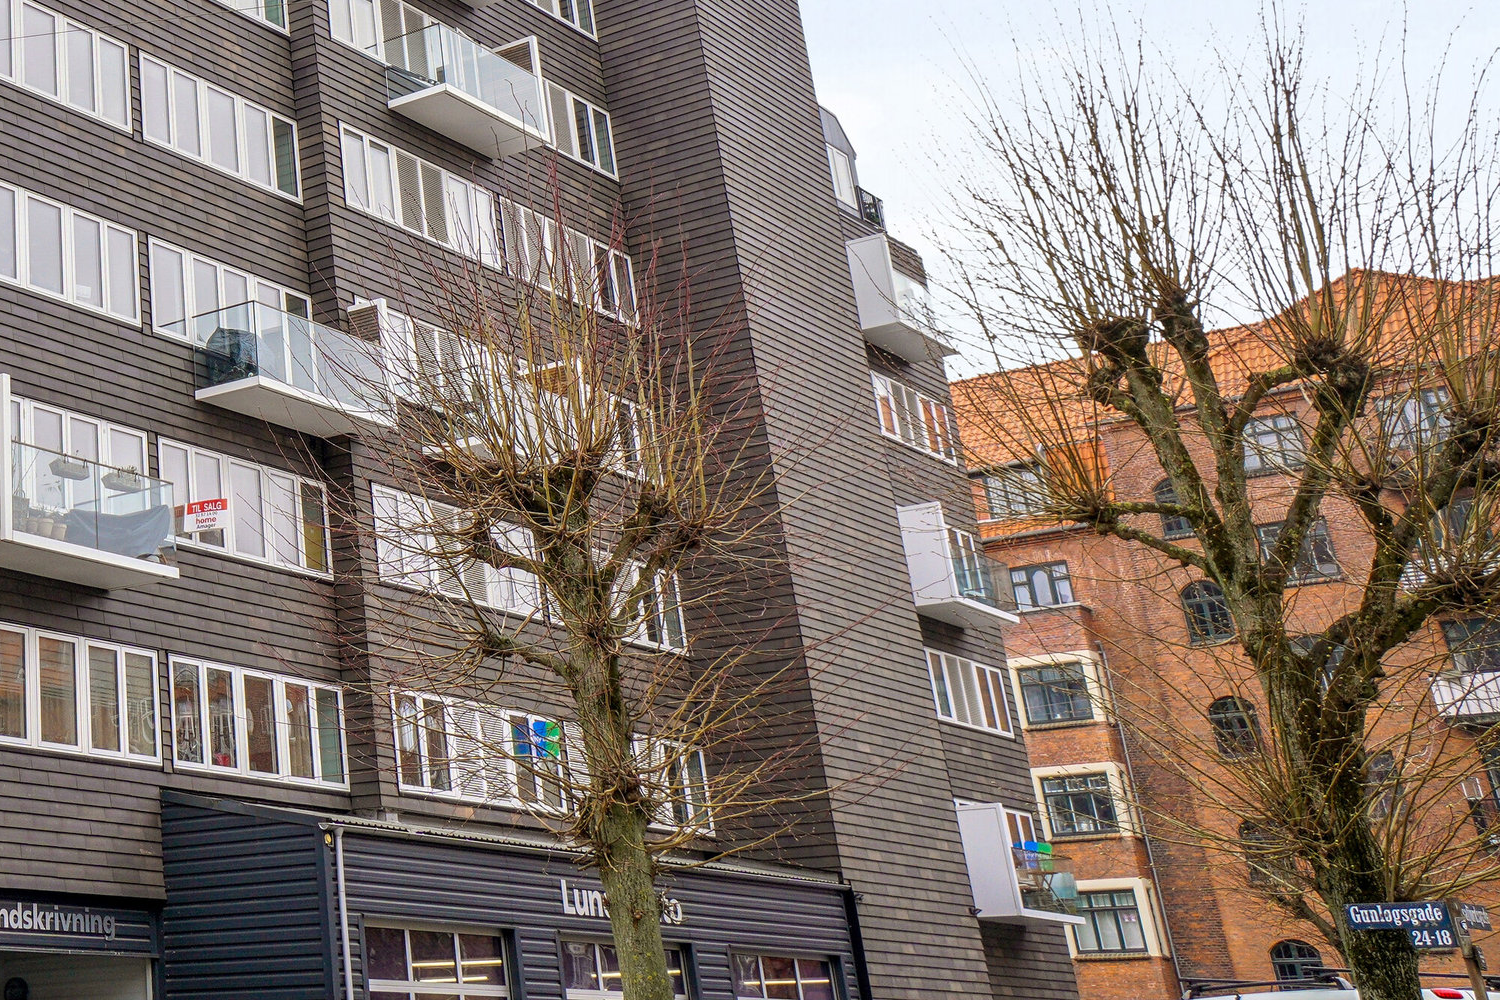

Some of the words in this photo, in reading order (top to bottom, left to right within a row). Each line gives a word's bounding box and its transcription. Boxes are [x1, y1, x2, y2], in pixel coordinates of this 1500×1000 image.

[192, 504, 202, 513] TIL
[204, 501, 221, 511] SALG
[196, 517, 216, 525] home
[560, 879, 611, 919] Lun
[1412, 929, 1453, 946] 24-18
